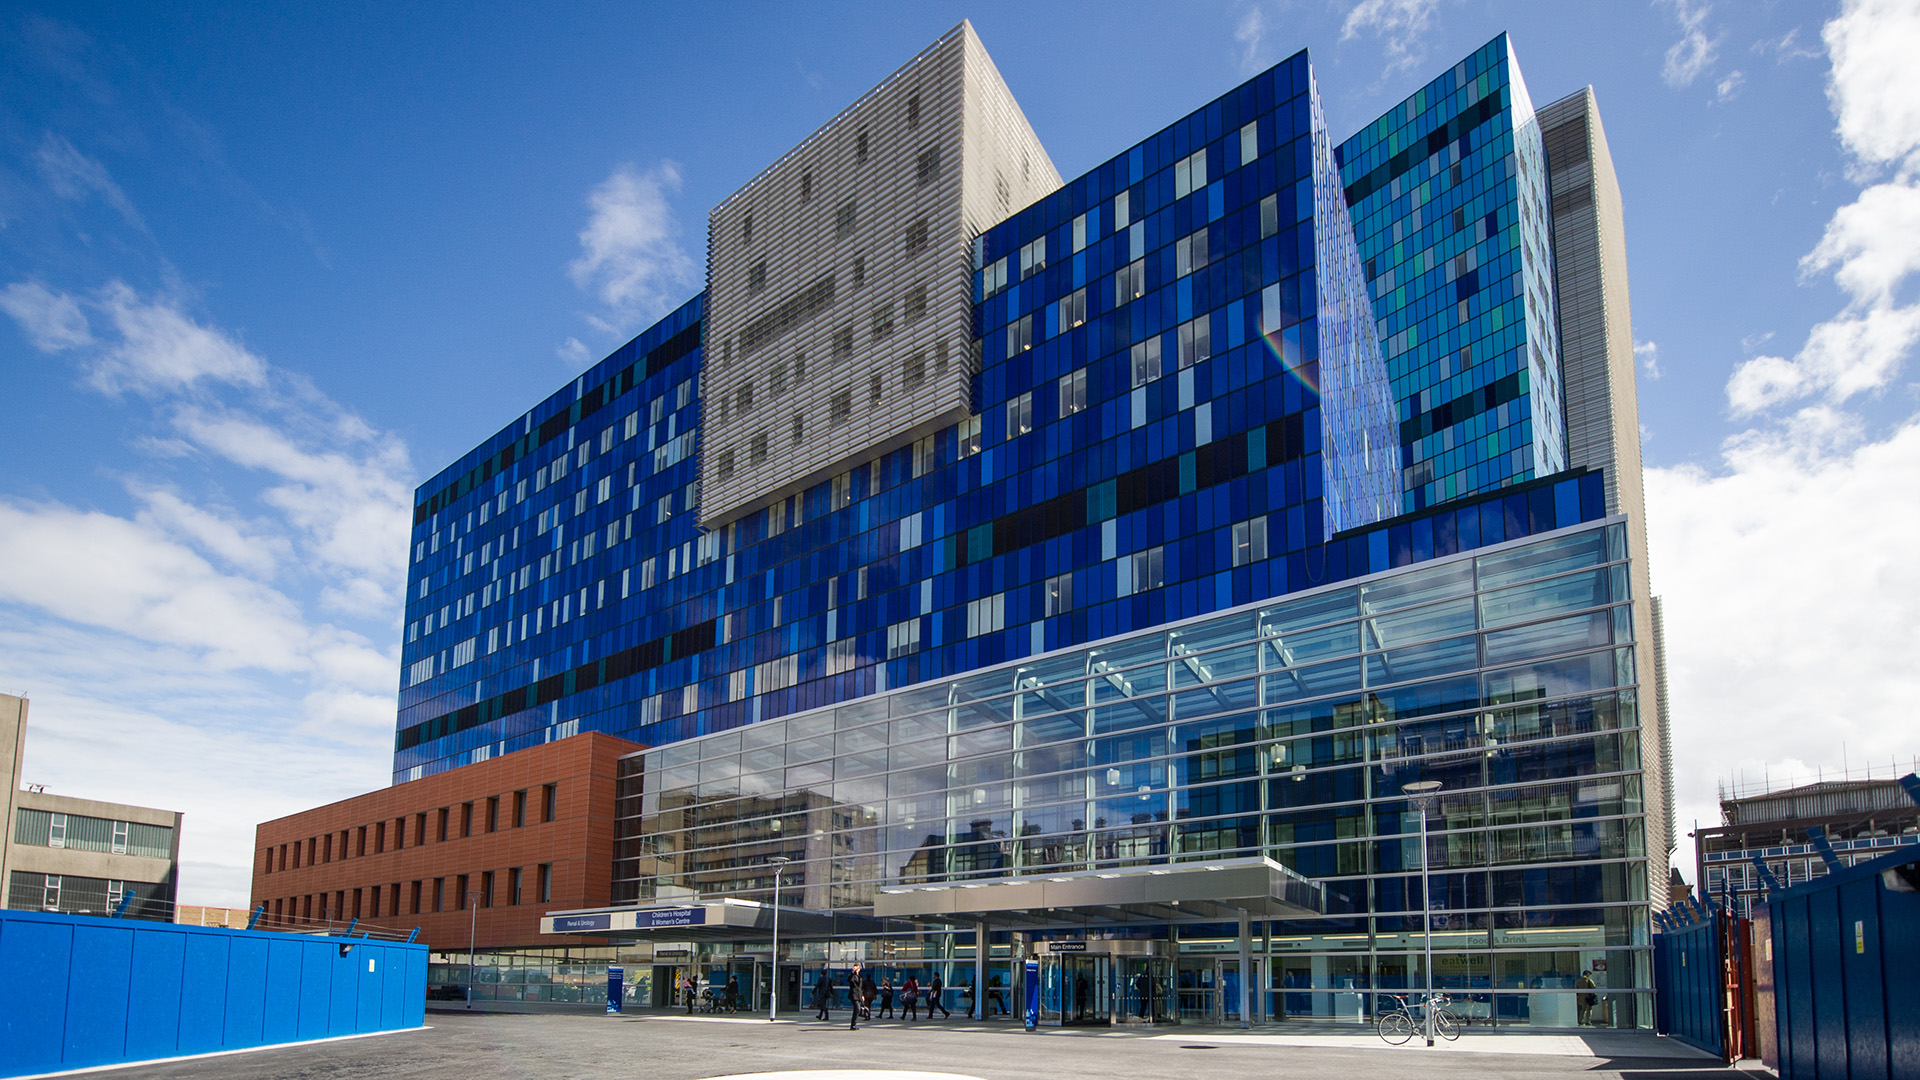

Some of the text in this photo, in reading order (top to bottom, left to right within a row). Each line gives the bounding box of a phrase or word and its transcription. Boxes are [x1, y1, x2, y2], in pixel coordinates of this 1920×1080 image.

[652, 910, 692, 919] Children's Hospital
[656, 918, 675, 926] Women's
[1502, 936, 1527, 944] Drink
[1441, 956, 1484, 965] eatwell
